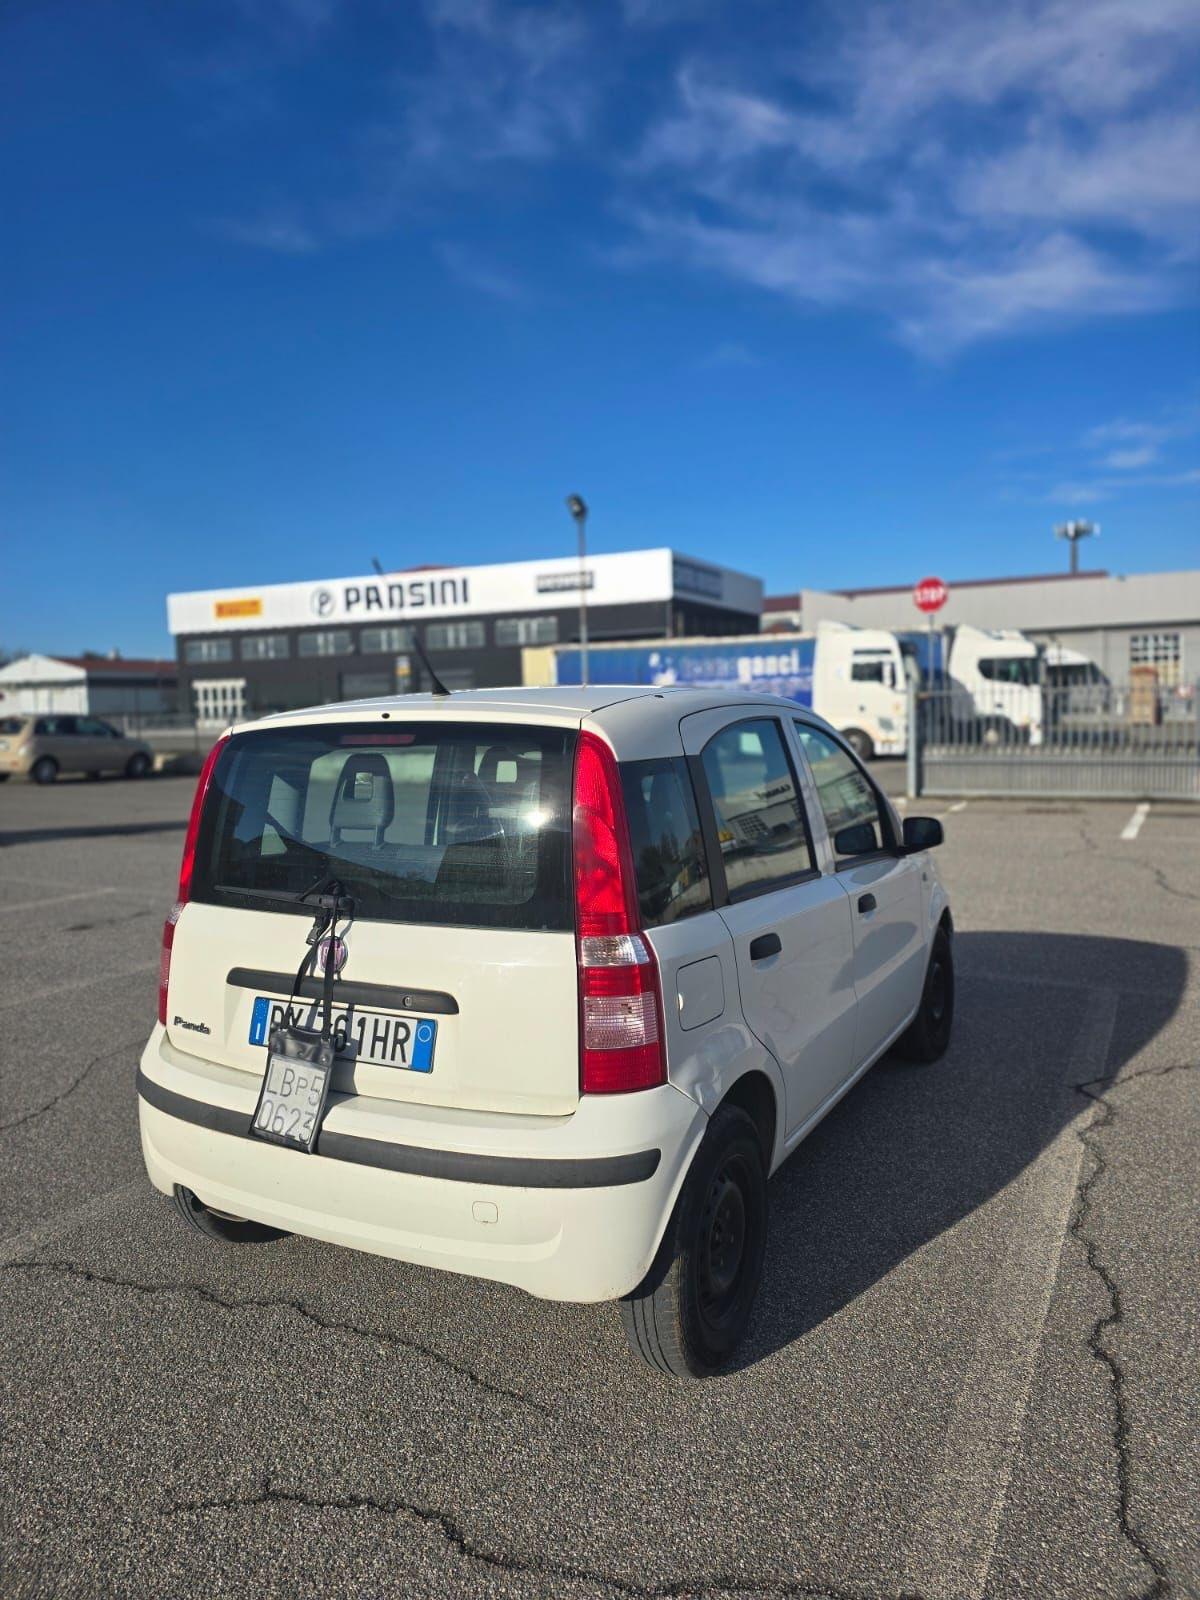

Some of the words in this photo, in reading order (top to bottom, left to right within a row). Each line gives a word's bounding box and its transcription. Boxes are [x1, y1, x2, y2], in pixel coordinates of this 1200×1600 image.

[345, 578, 468, 611] PANSINI
[914, 586, 945, 602] STOP
[173, 1015, 211, 1035] Panda
